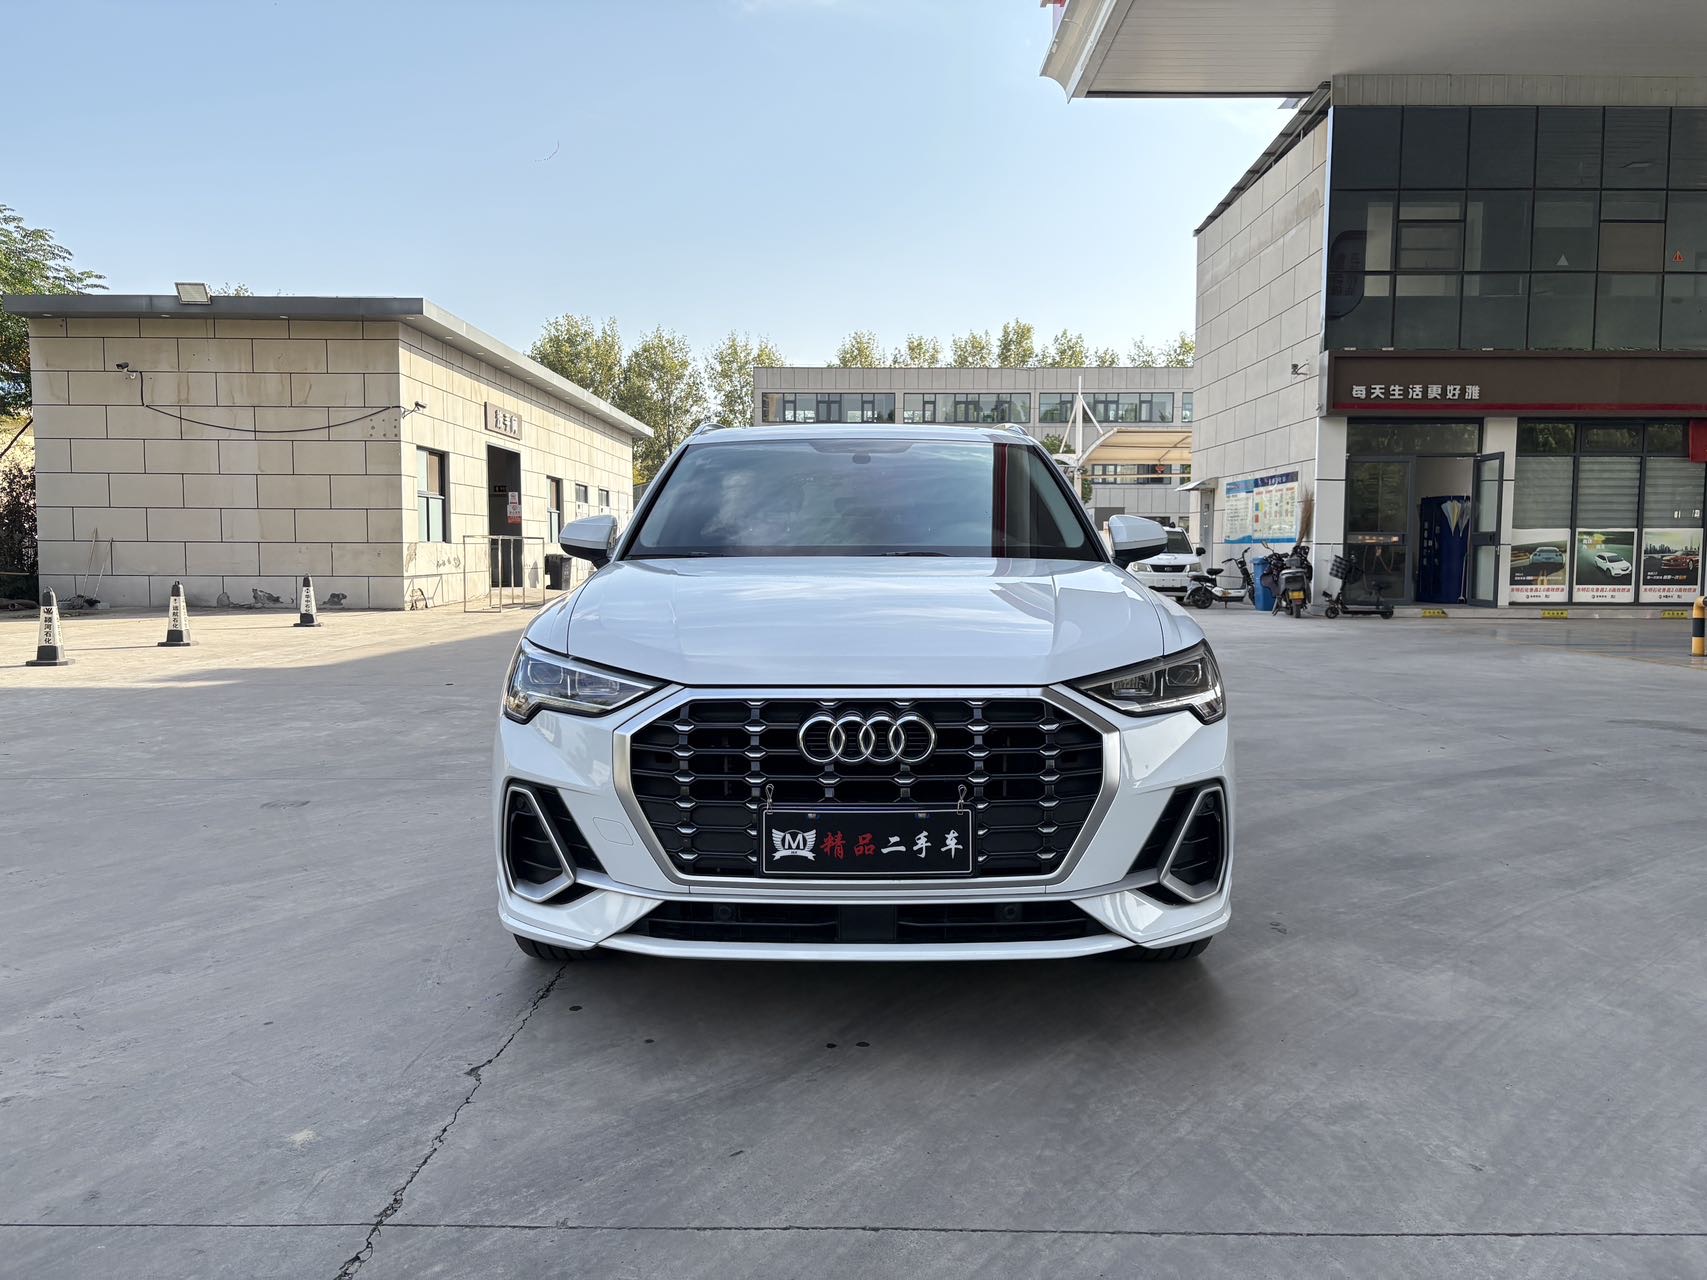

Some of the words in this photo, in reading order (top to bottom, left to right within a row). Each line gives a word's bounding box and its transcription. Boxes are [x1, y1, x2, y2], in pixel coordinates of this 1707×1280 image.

[1352, 384, 1481, 399] 每天生活更好雅
[784, 833, 804, 849] M
[820, 830, 963, 859] 精品二手车
